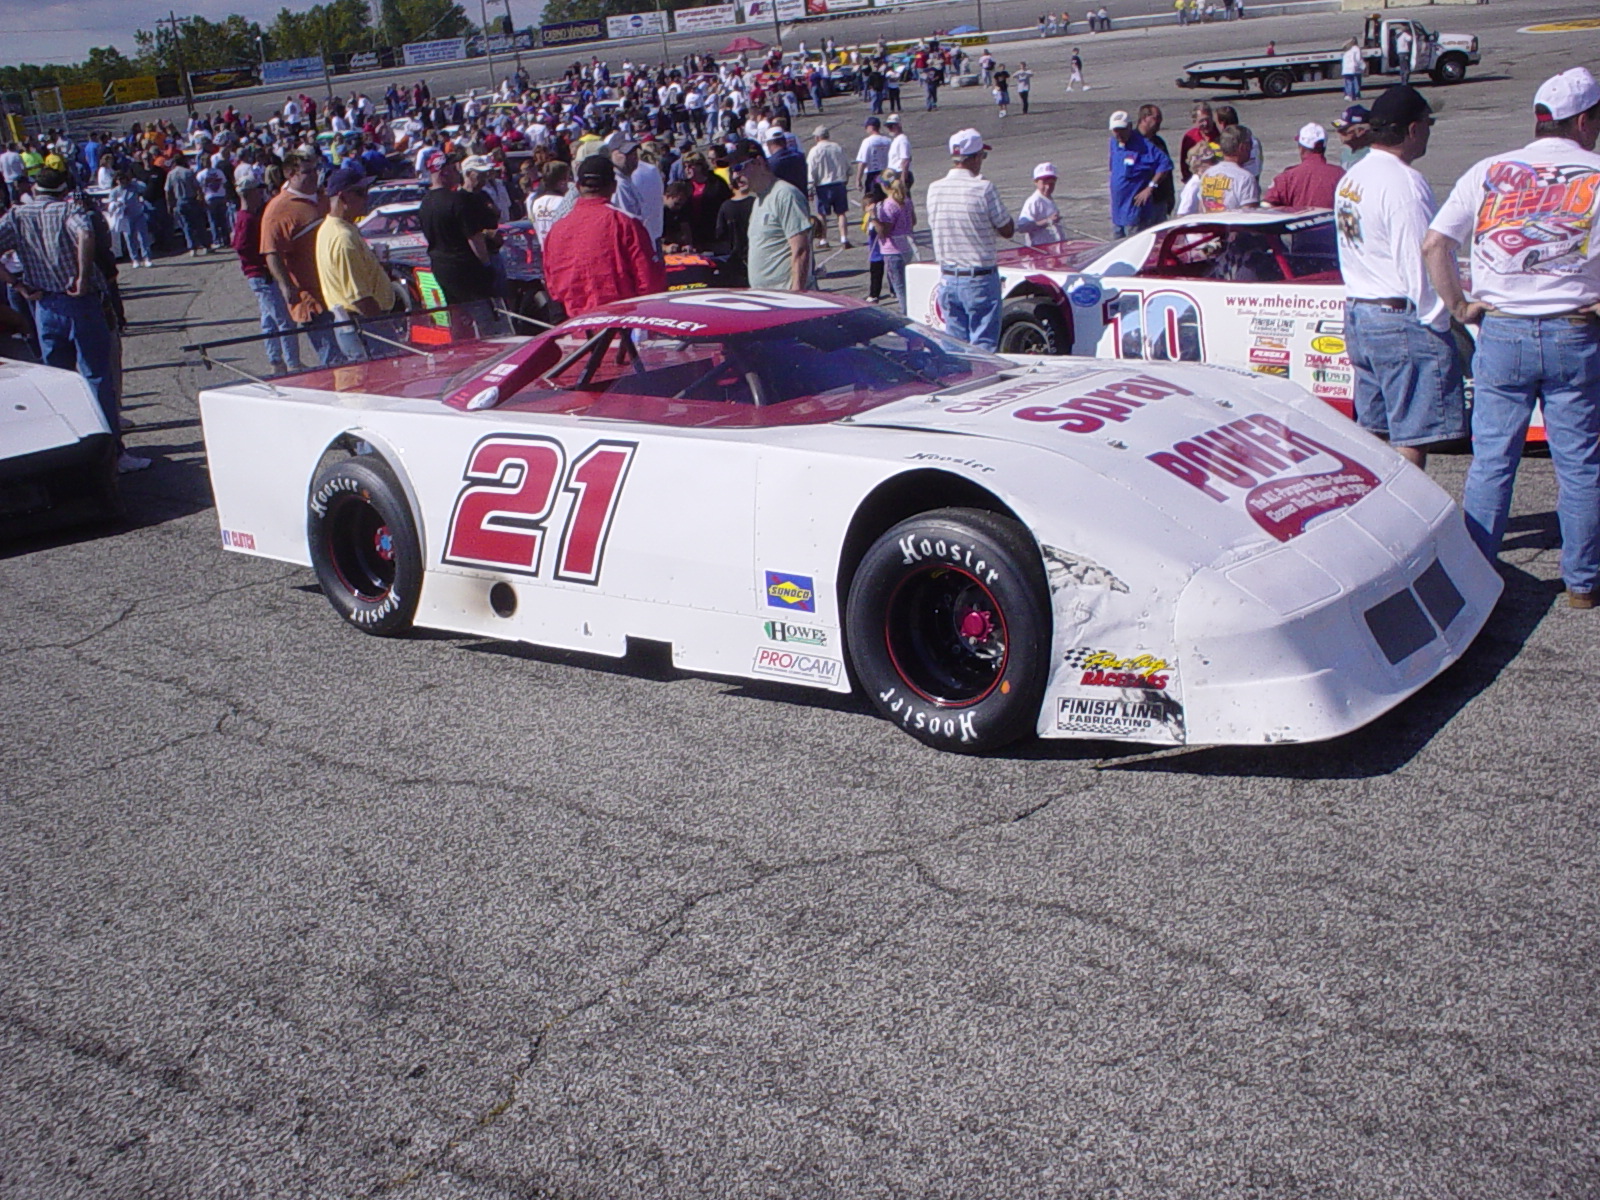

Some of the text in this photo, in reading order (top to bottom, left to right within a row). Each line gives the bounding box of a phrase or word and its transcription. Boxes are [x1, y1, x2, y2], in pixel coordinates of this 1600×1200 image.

[1475, 172, 1600, 233] LANDIS
[622, 316, 708, 332] PARSLEY
[1013, 374, 1194, 433] Spray
[904, 452, 995, 473] Hoosier
[1145, 413, 1320, 503] POWER
[310, 477, 360, 517] Hoosier
[440, 432, 639, 587] 21
[898, 533, 1000, 585] Hoosier
[350, 587, 400, 627] Hoosier
[771, 586, 811, 599] SUNOCO
[770, 620, 823, 642] HOWE
[758, 650, 836, 676] PRO/CAM
[1080, 671, 1170, 690] RACECARS
[879, 685, 979, 742] Hoosier
[1060, 699, 1163, 721] FINISH LINE
[1068, 714, 1152, 728] FABRICATING
